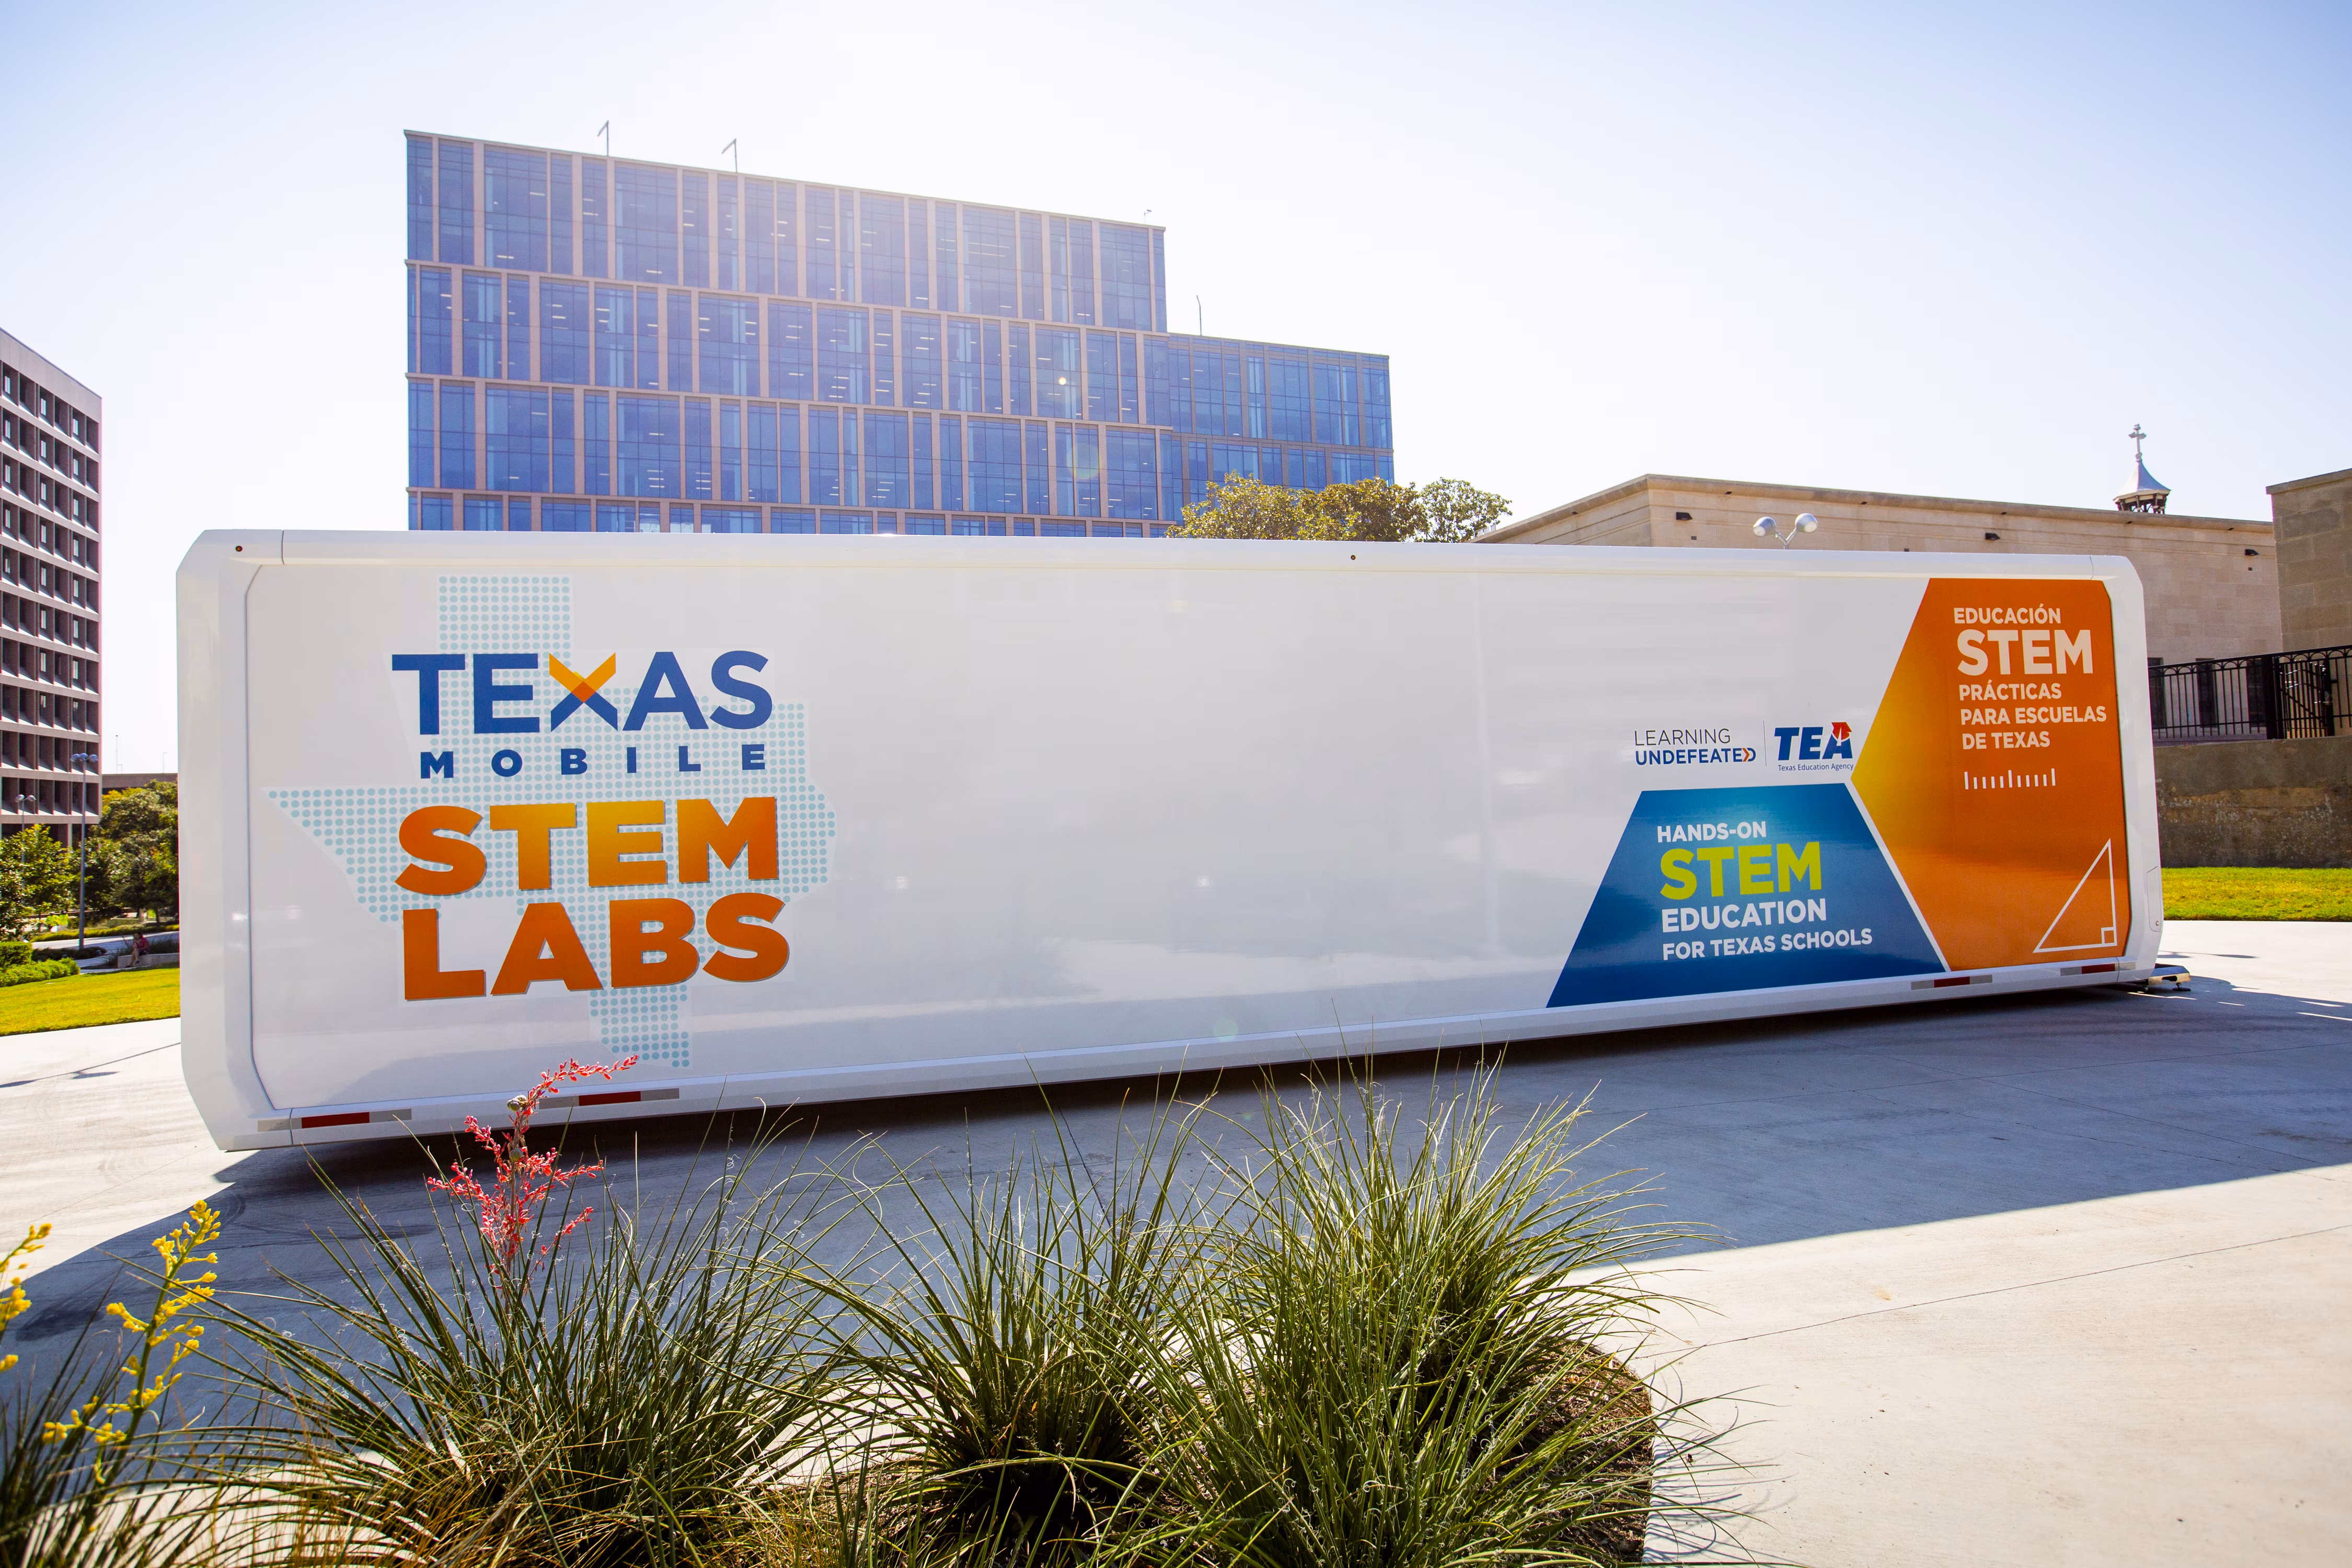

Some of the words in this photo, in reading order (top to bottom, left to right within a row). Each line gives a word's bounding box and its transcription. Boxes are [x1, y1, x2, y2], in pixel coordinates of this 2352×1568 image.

[1954, 603, 2061, 624] EDUCACIÓN
[1957, 629, 2093, 676] STEM
[392, 650, 773, 735] TEXAS
[1959, 680, 2062, 701] PRÁCTICAS
[1961, 708, 2010, 725] PARA
[2015, 706, 2107, 723] ESCUELAS
[1634, 729, 1731, 746] LEARNING
[1774, 722, 1853, 760] TEA
[1962, 733, 1987, 750] DE
[1991, 731, 2050, 748] TEXAS
[420, 744, 766, 779] MOBILE
[1635, 747, 1756, 765] UNDEFEATED
[1831, 763, 1854, 771] Agency
[395, 797, 779, 895] STEM
[1657, 821, 1767, 843] HANDS-ON
[1660, 841, 1822, 900] STEM
[1662, 898, 1826, 932] EDUCATION
[403, 892, 790, 1001] LABS
[1663, 941, 1705, 961] FOR
[1710, 936, 1775, 956] TEXAS
[1781, 928, 1873, 951] SCHOOLS
